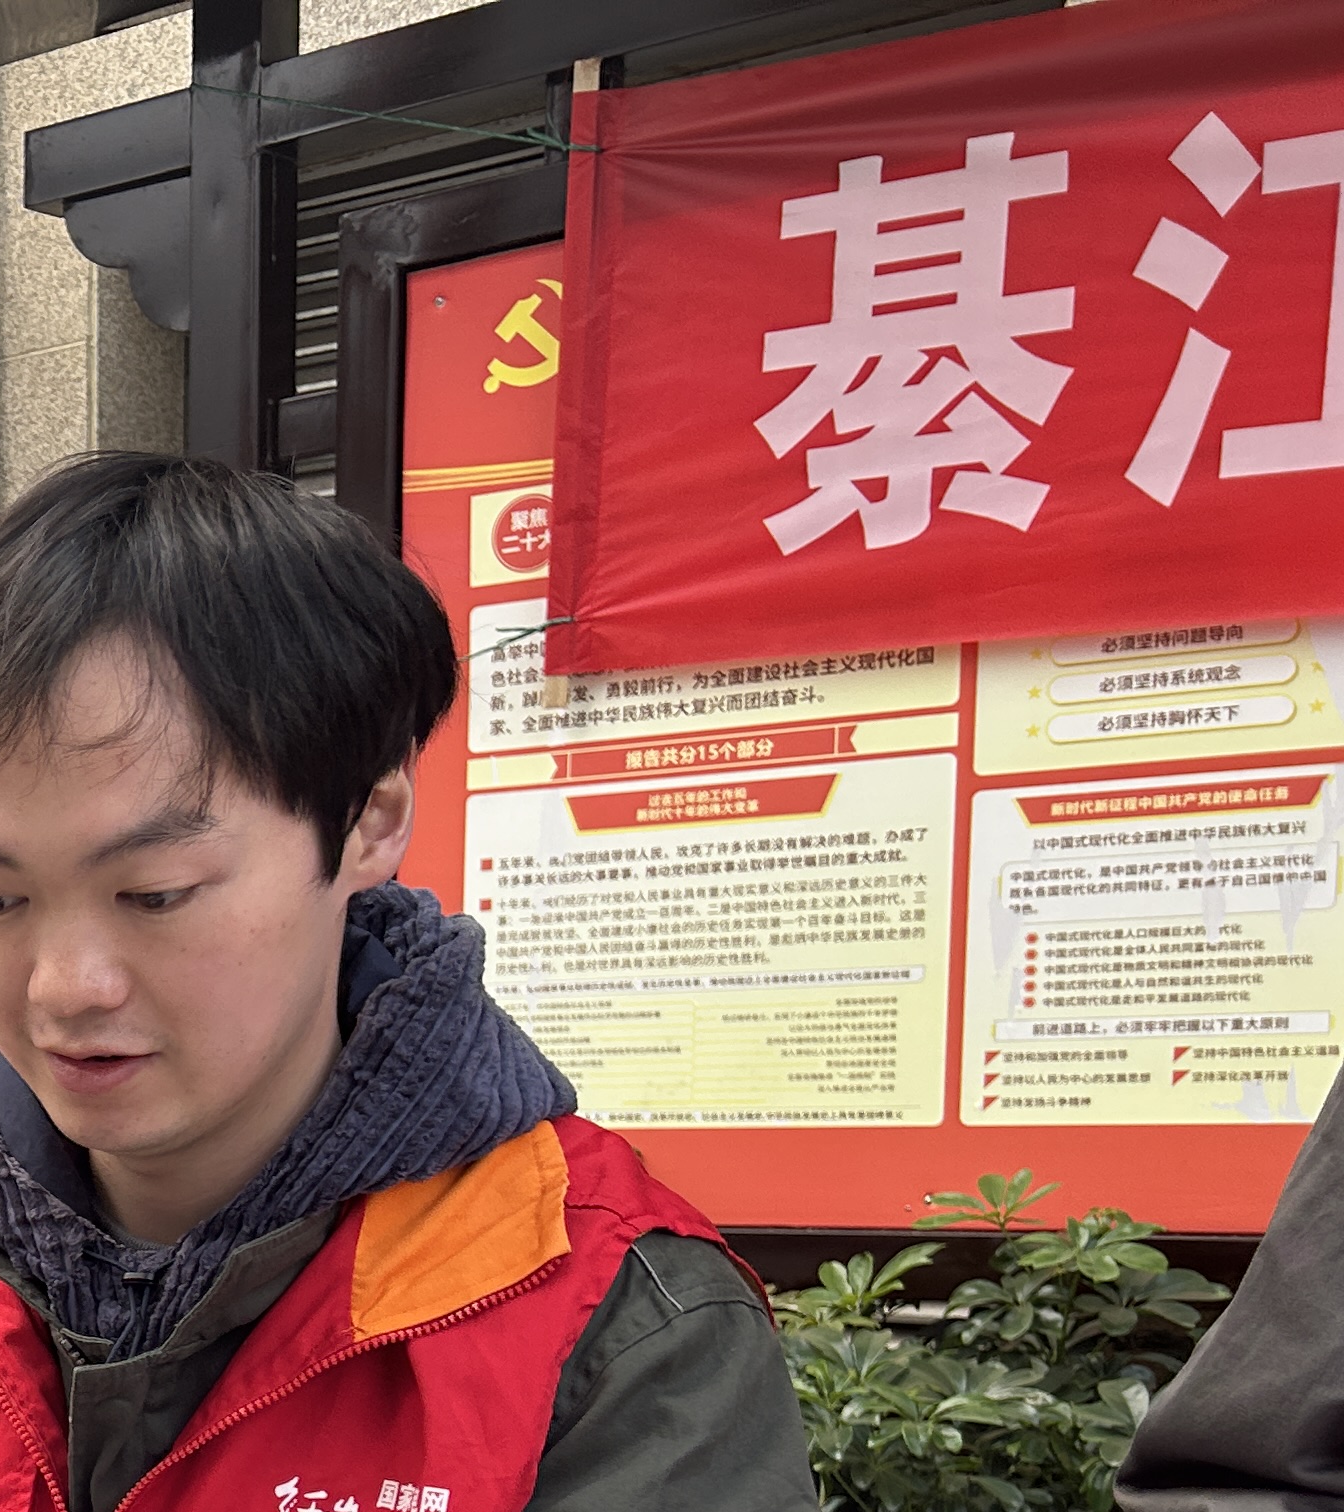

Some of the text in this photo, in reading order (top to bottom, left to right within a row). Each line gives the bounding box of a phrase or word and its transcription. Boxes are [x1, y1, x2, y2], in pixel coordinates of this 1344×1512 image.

[753, 111, 1344, 556] 綦江
[511, 508, 548, 531] 聚焦
[501, 531, 551, 554] 二十大
[490, 642, 545, 663] 高举中
[1101, 624, 1244, 653] 必须坚持问题导向
[490, 664, 544, 688] 色社会
[1099, 664, 1242, 693] 必须坚持系统观念
[1097, 704, 1240, 732] 必须坚持胸怀天下
[625, 738, 774, 770] 报告共分15个部分
[1050, 786, 1289, 817] 新时代新征程中国共产党的使命任务
[1033, 820, 1306, 850] 以中国式现代化全面推进中华民族伟大复兴
[1044, 924, 1243, 942] 中国式现代化是人口规模巨大的代化
